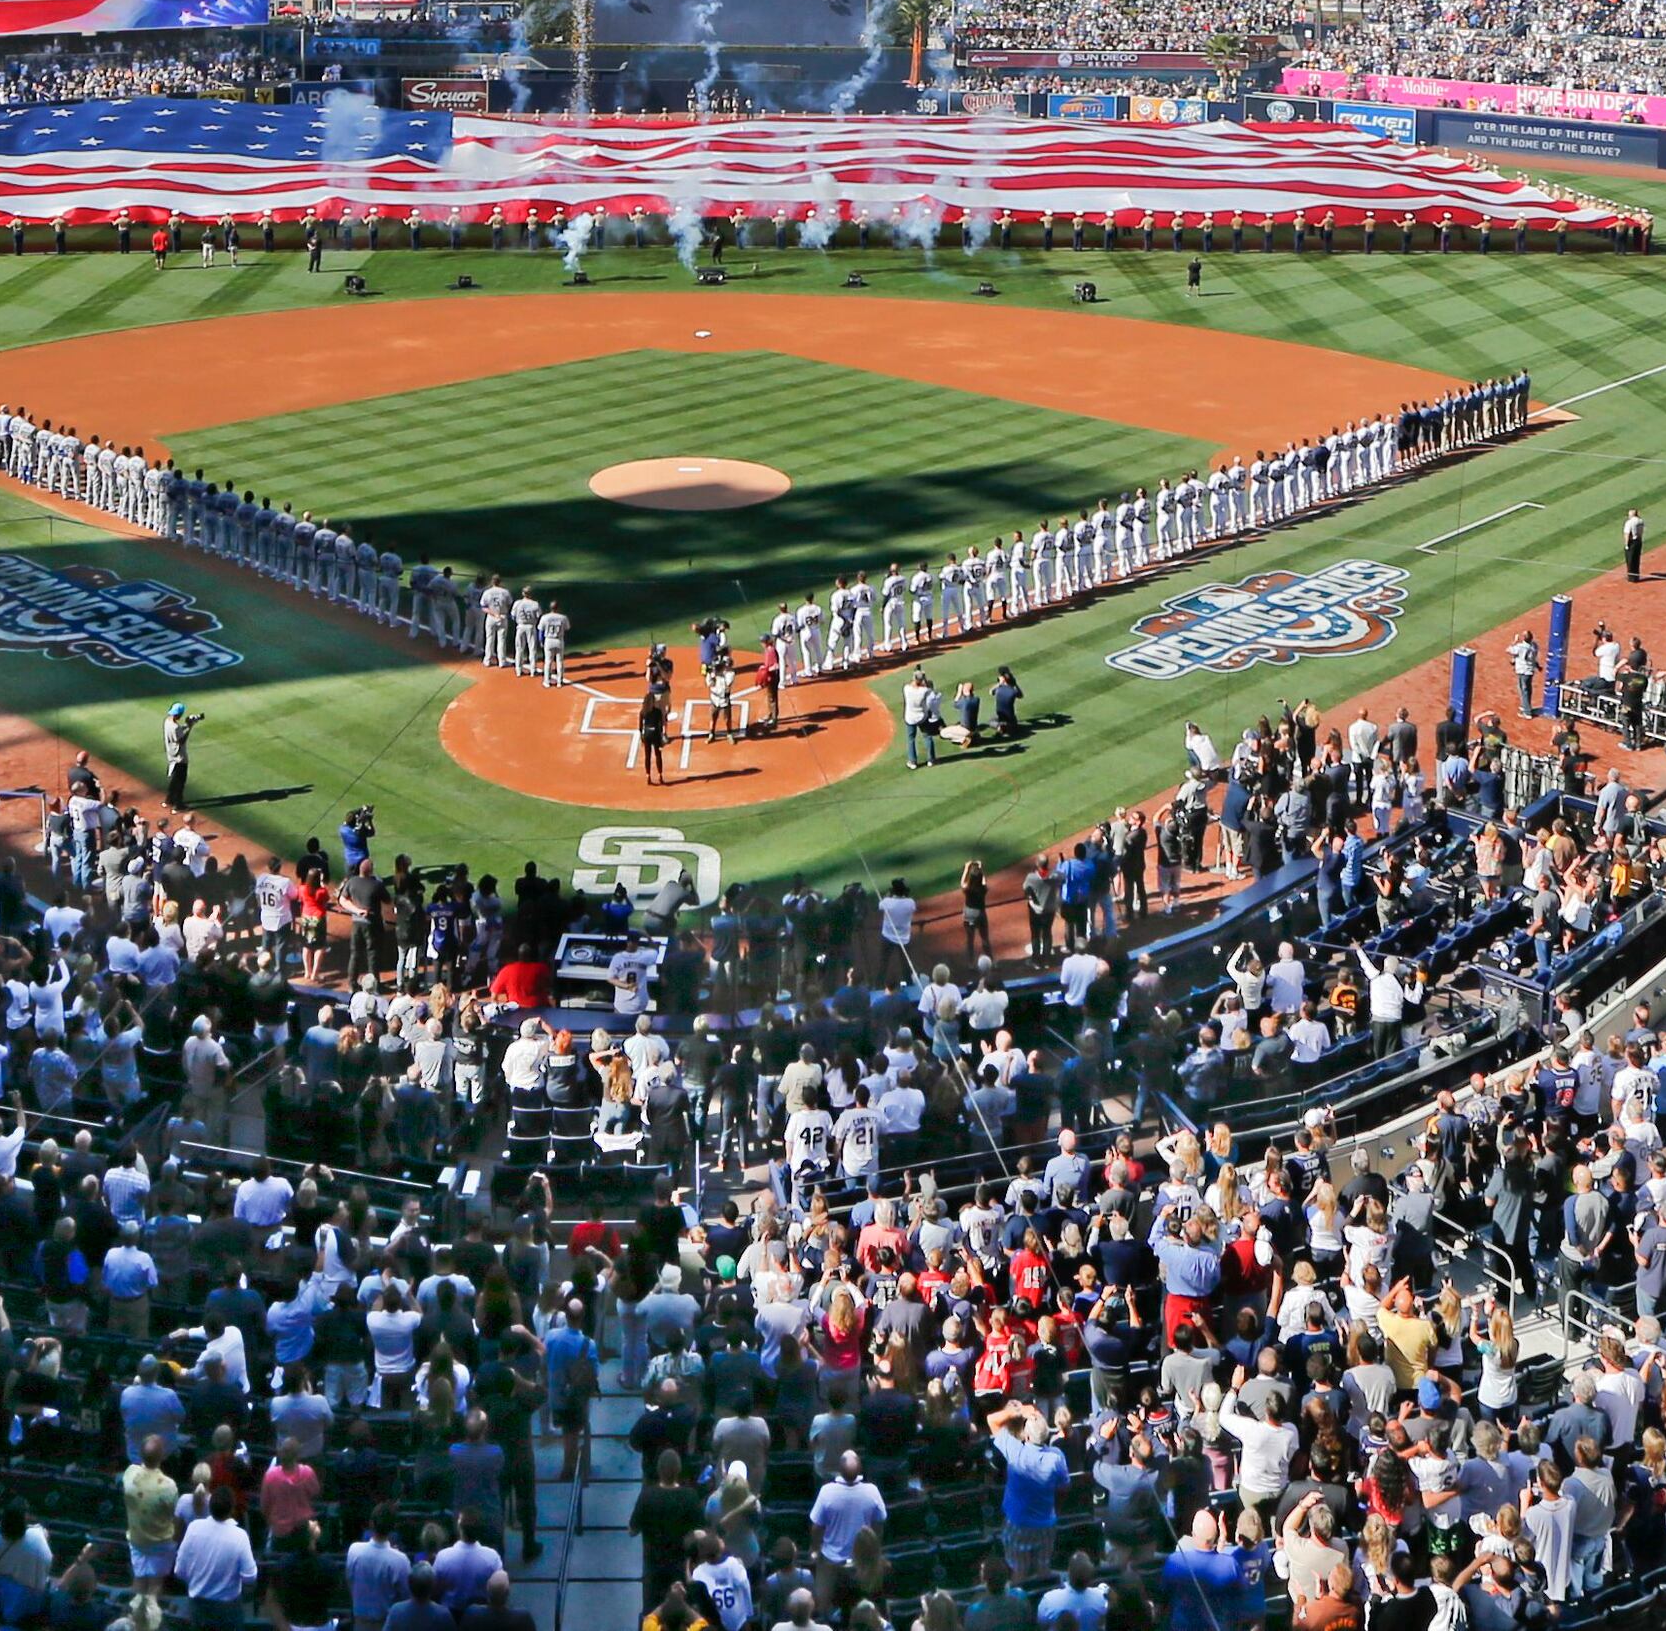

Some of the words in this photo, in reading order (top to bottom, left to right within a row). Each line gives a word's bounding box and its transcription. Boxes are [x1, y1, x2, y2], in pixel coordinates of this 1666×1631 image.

[1074, 54, 1098, 63] SUN
[1100, 54, 1138, 63] DIEGO
[406, 81, 482, 106] Sycuan
[1516, 87, 1563, 107] HOME
[1565, 91, 1589, 108] RUN
[916, 99, 938, 113] 396
[1474, 121, 1496, 132] O'ER
[1499, 123, 1518, 134] THE
[1521, 126, 1547, 136] LAND
[1549, 128, 1562, 137] OF
[1565, 129, 1584, 140] THE
[1587, 131, 1614, 142] FREE
[1467, 134, 1487, 144] AND
[1490, 136, 1508, 147] THE
[1511, 138, 1539, 150] HOME
[1542, 141, 1555, 151] OF
[1558, 142, 1577, 153] THE
[1580, 144, 1621, 157] BRAVE?
[1124, 602, 1300, 675] OPENING
[1267, 560, 1403, 613] SERIES
[84, 615, 233, 673] SERIES
[261, 891, 276, 907] 16
[439, 916, 447, 931] 9
[799, 1125, 823, 1144] 42
[855, 1125, 874, 1144] 21
[711, 1586, 736, 1610] 66
